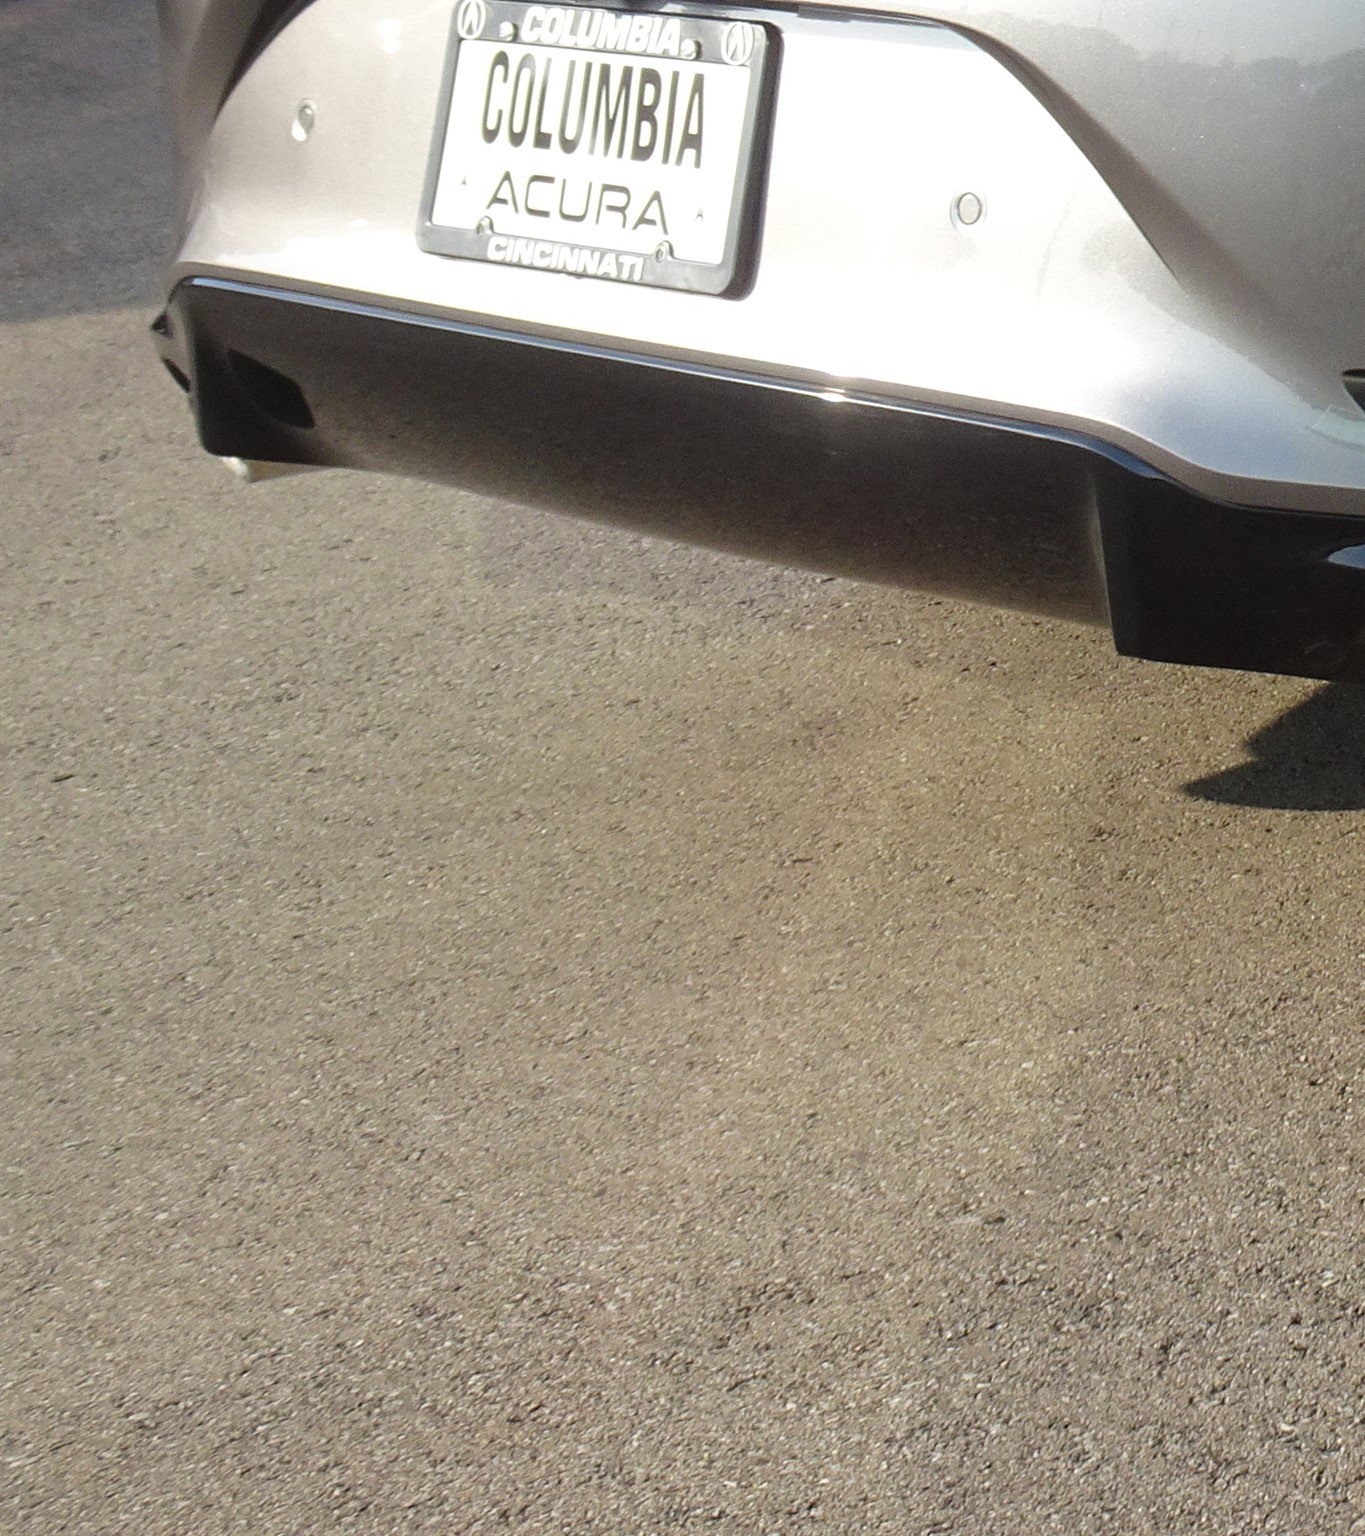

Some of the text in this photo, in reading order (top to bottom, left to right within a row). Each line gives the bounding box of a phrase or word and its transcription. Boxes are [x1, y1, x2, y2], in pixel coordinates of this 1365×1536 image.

[519, 6, 682, 58] COLUMBIA
[481, 50, 705, 169] COLUMBIA
[485, 170, 669, 235] ACURA
[486, 236, 645, 282] CINCINNATI
